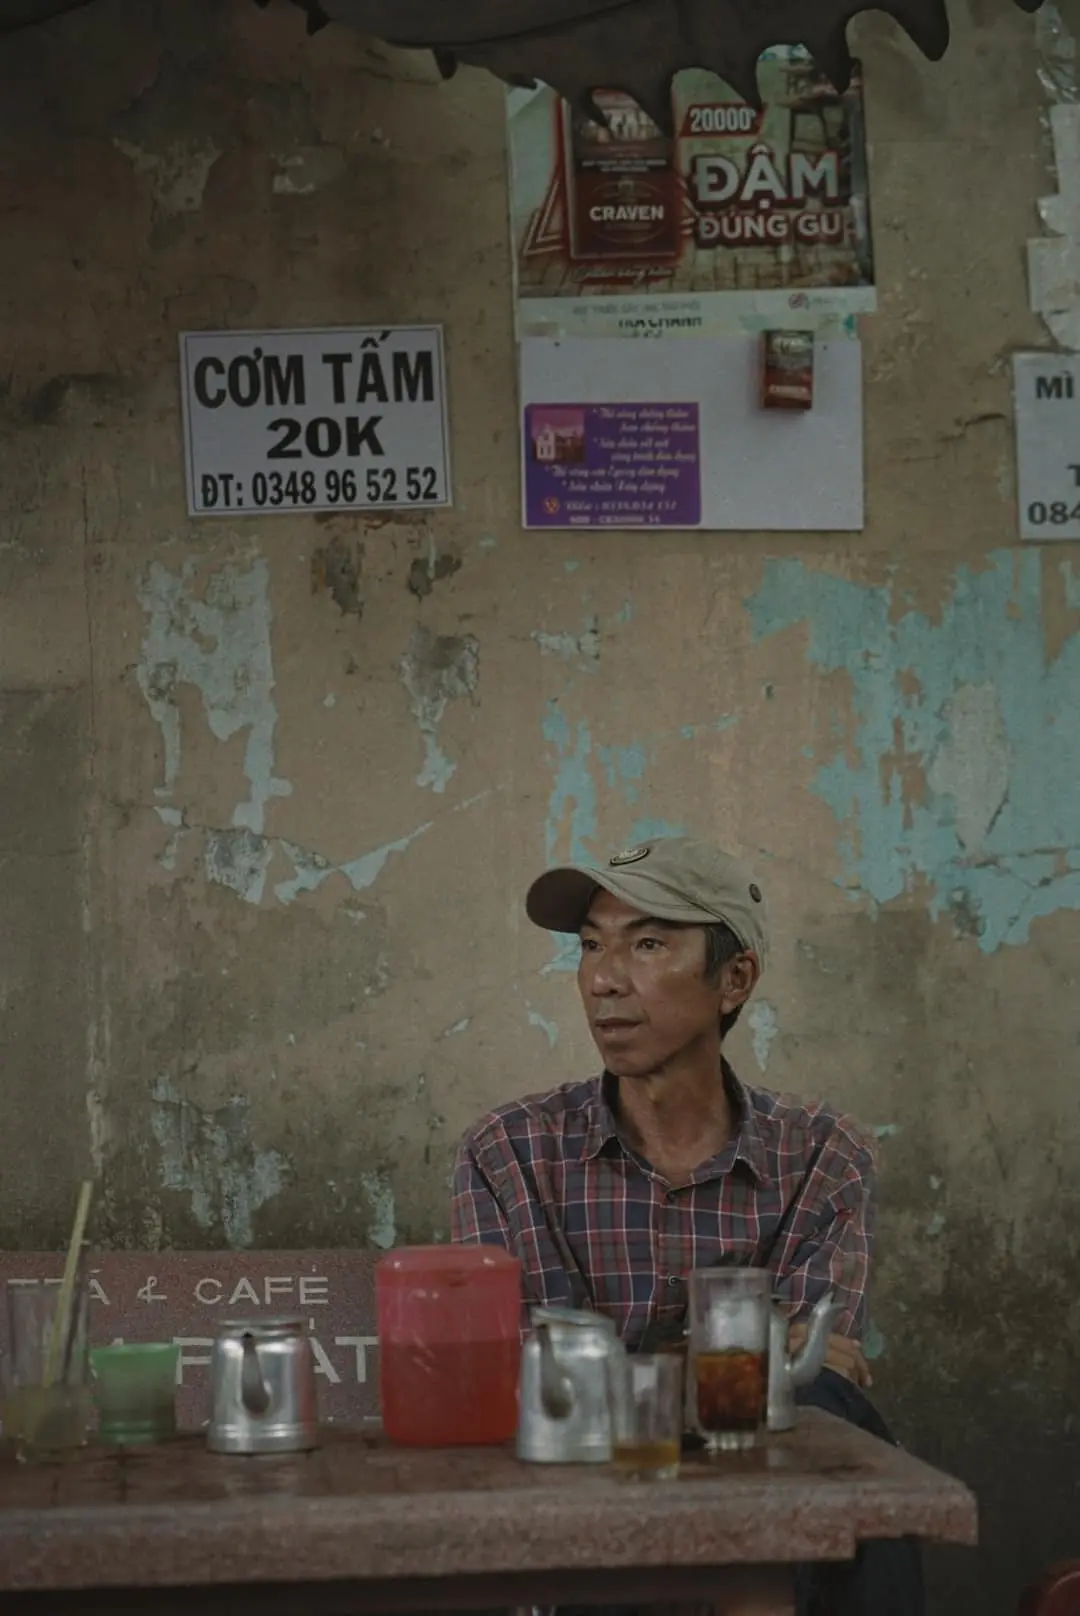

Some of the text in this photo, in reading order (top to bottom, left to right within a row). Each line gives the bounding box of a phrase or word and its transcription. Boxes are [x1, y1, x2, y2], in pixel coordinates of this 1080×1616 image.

[694, 145, 840, 209] ĐẬM
[589, 204, 665, 222] CRAVEN
[797, 213, 841, 237] GU
[194, 330, 435, 409] CƠM TẤM
[1035, 370, 1075, 400] MÌ
[266, 415, 385, 460] 20K
[201, 466, 438, 508] ĐT: 0348 96 52 52
